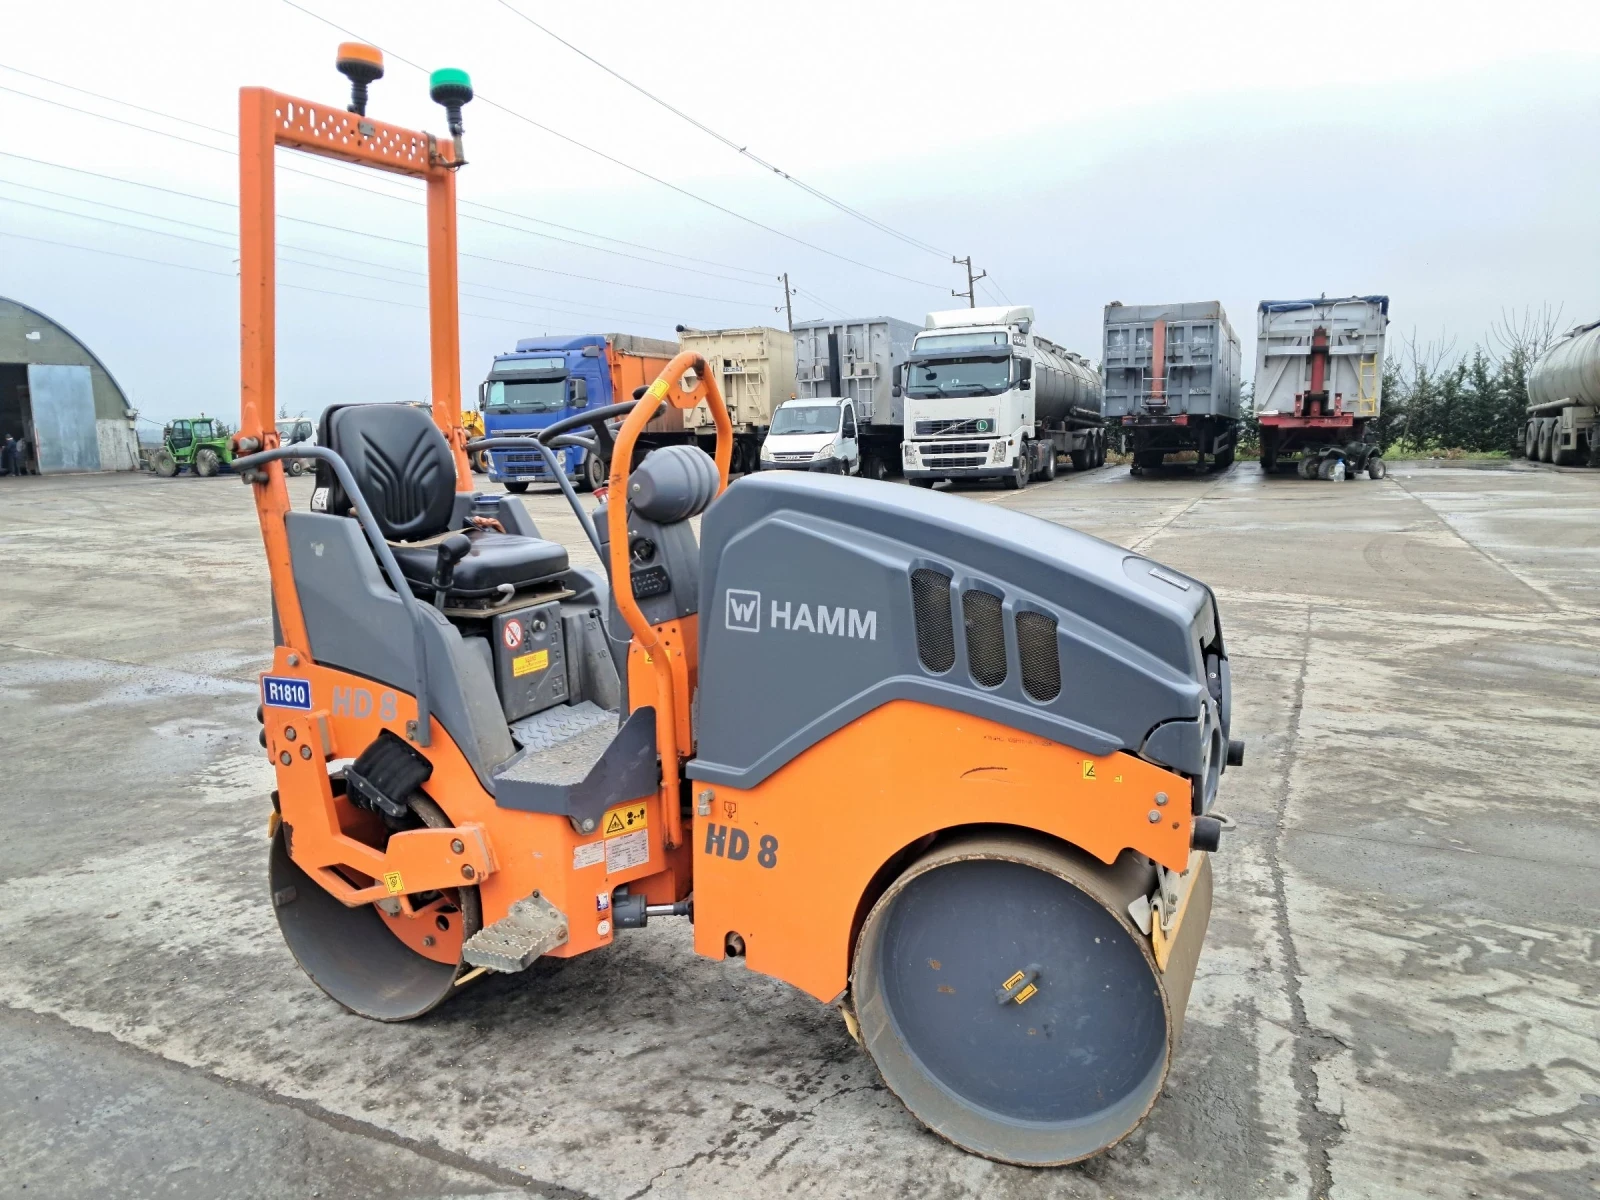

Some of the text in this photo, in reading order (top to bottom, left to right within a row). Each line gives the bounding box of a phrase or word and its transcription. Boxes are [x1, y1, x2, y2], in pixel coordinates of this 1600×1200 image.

[770, 600, 877, 640] HAMM
[269, 682, 305, 704] R1810
[332, 685, 398, 722] HD 8
[705, 822, 779, 869] HD 8
